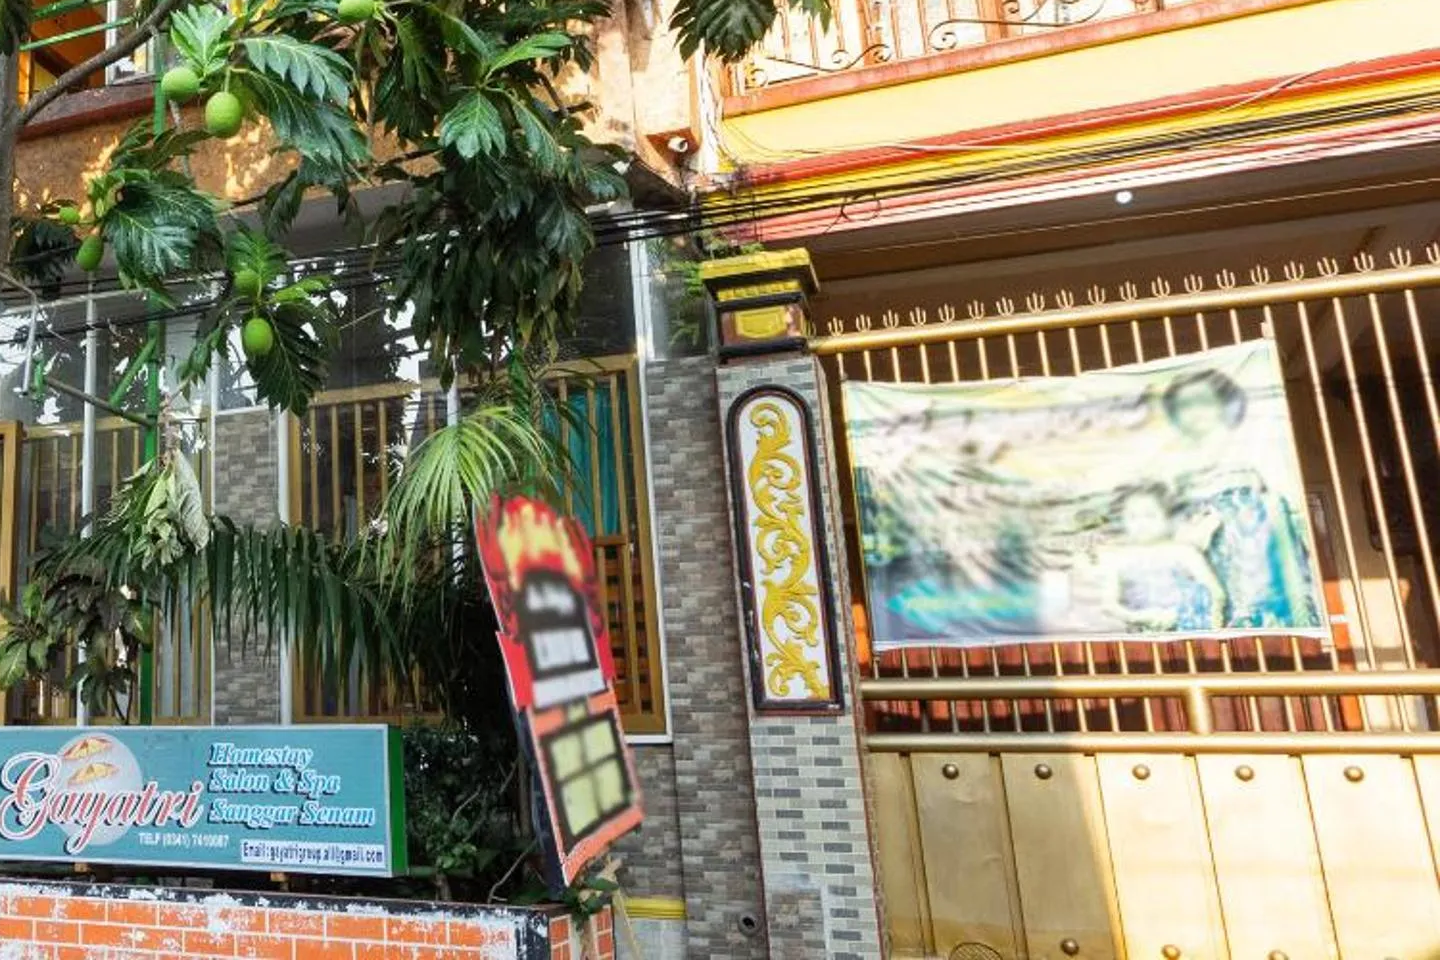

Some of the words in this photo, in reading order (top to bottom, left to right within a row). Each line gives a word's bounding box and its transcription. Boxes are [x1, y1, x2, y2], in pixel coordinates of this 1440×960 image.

[208, 742, 313, 771] Homestay
[209, 767, 270, 793] Salon
[272, 767, 295, 793] &
[296, 769, 341, 800] Spa
[208, 798, 299, 829] Sanggar
[298, 800, 376, 828] Senam
